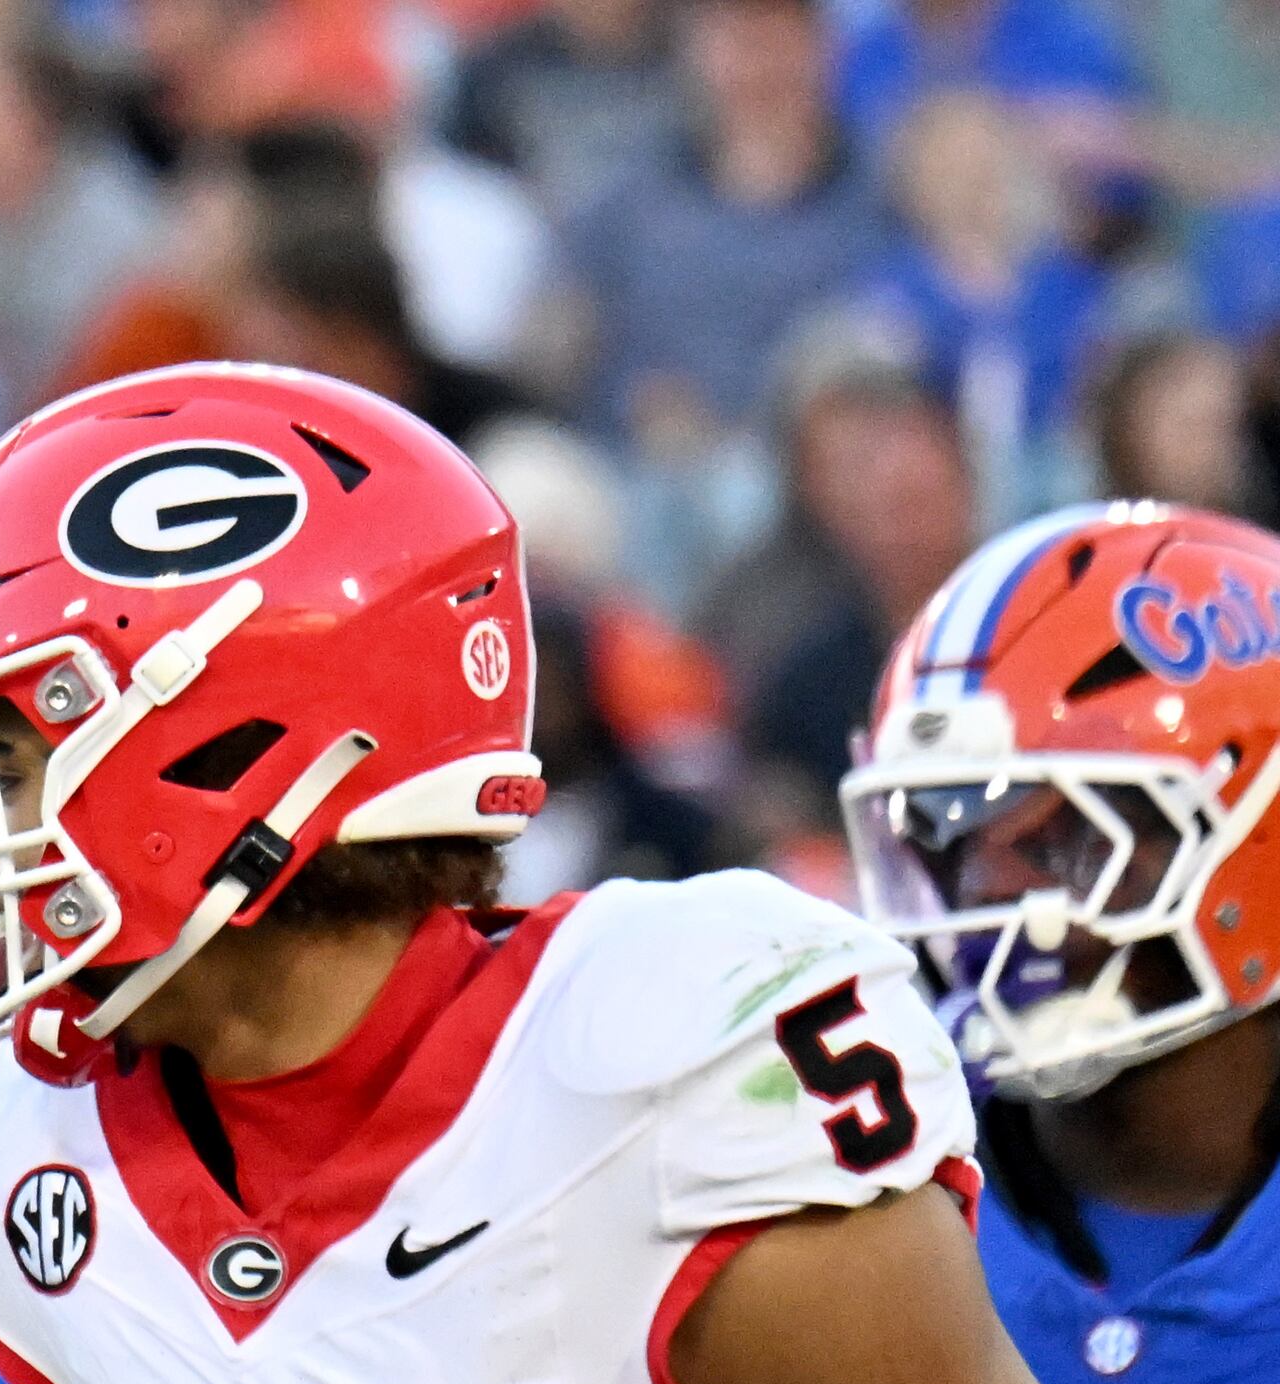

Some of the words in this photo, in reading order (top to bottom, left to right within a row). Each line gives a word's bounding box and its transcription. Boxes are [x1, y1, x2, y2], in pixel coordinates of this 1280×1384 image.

[62, 441, 304, 586] G
[775, 976, 919, 1173] 5
[10, 1169, 88, 1286] SEC
[208, 1237, 284, 1302] G
